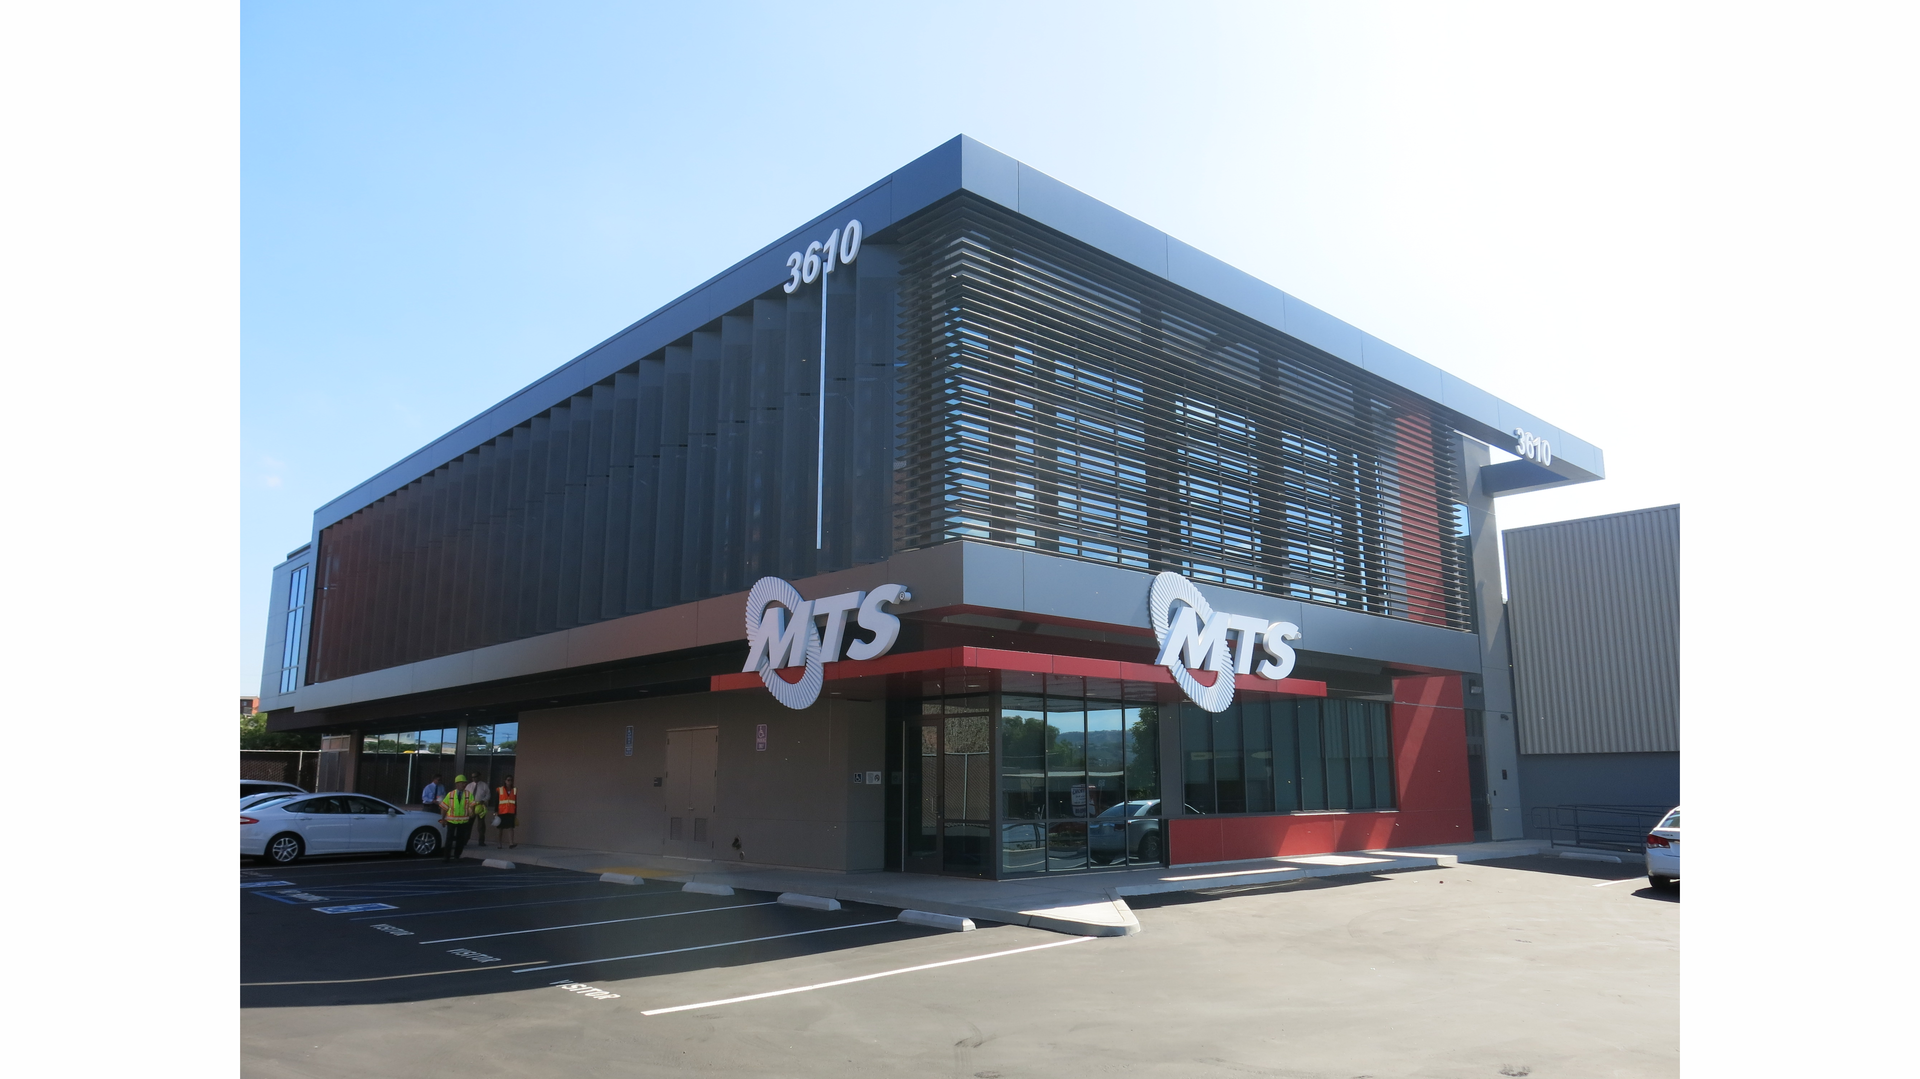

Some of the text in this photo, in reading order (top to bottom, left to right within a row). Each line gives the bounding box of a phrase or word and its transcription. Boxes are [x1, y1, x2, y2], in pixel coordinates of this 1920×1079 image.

[783, 219, 863, 294] 3610
[1513, 427, 1551, 467] 3610
[742, 583, 909, 673] MTS
[1154, 606, 1300, 681] MTS
[549, 979, 621, 1000] VISITOR
